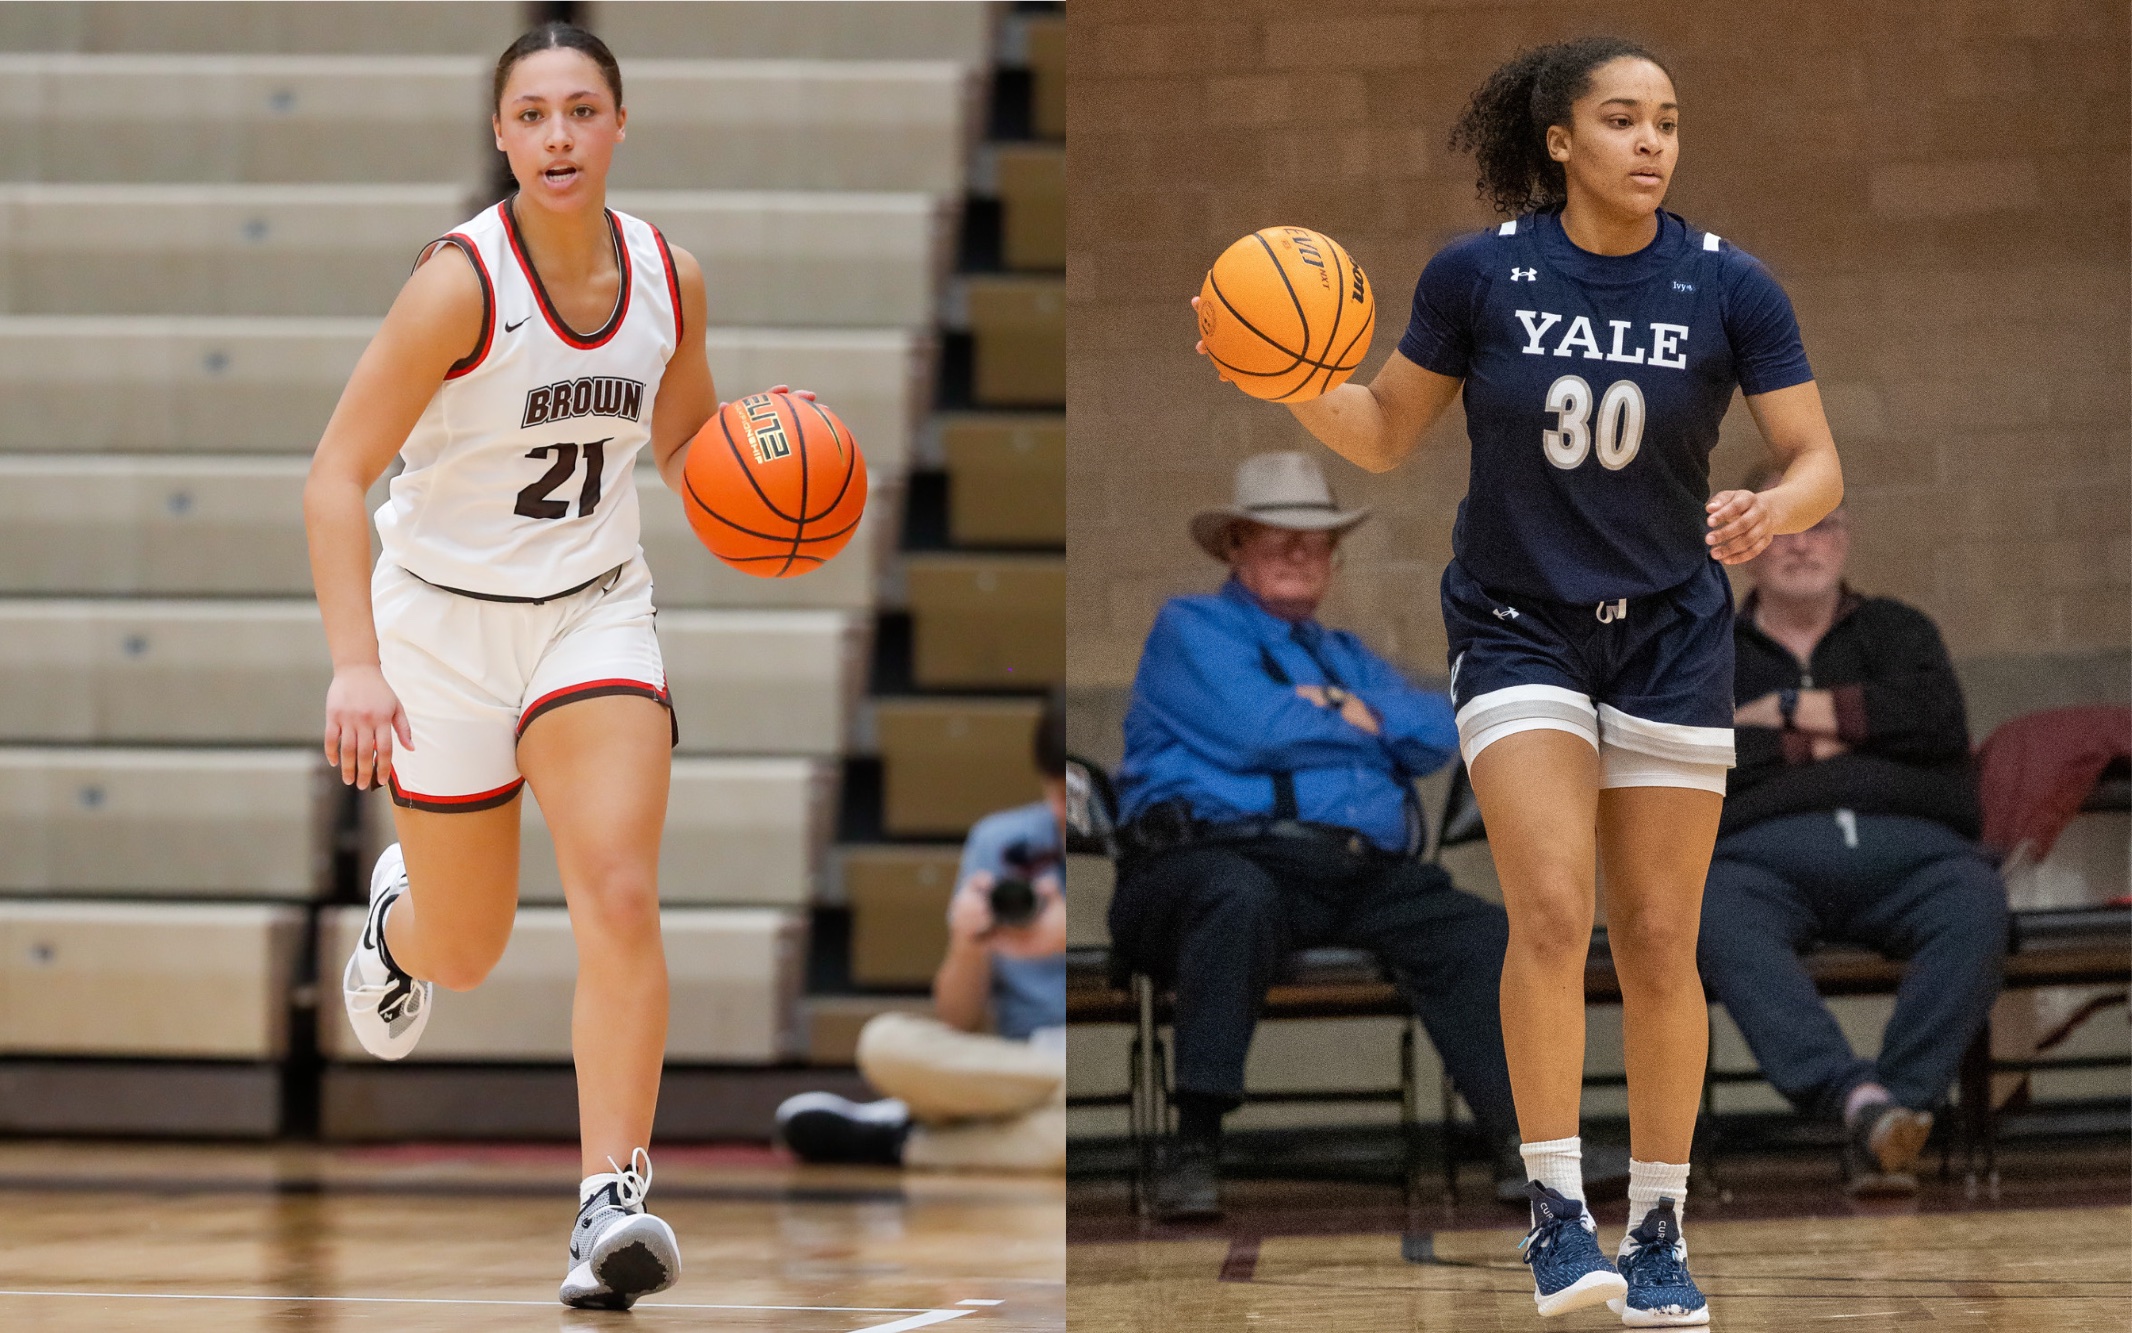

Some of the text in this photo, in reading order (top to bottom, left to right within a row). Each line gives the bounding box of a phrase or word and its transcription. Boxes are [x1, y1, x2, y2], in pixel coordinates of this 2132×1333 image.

[1515, 310, 1689, 369] YALE
[520, 376, 644, 430] BROWN
[1543, 374, 1646, 471] 30
[514, 437, 614, 519] 21
